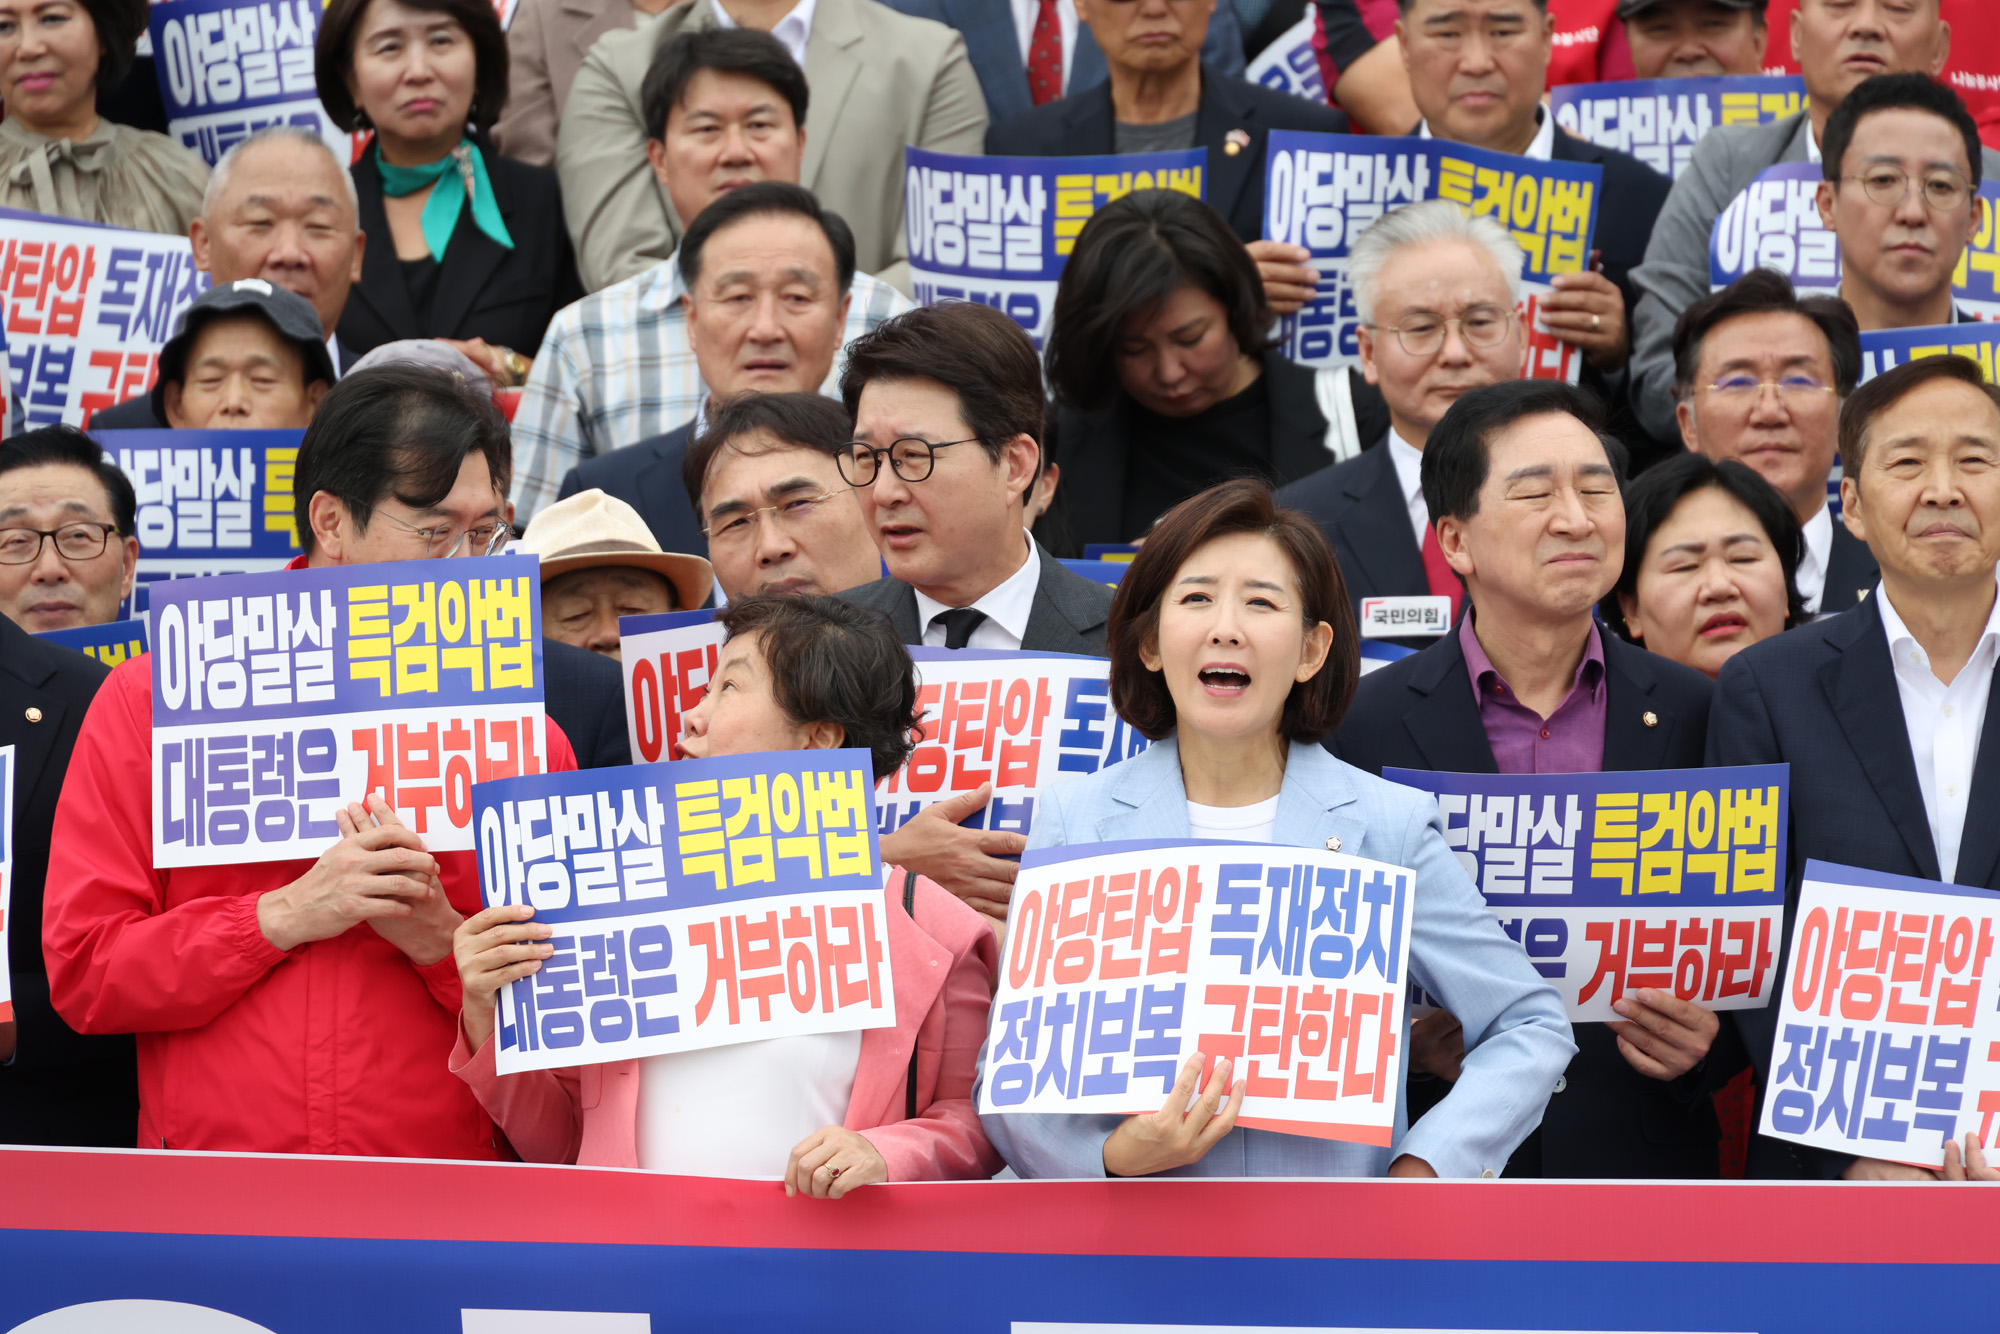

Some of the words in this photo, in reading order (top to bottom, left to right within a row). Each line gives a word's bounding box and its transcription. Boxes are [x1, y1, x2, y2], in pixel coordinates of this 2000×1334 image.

[163, 0, 317, 107] 야당말살
[907, 166, 1047, 271] 야당말살
[159, 588, 337, 711] 야당말살
[348, 576, 534, 697] 특검악법
[1373, 607, 1439, 624] 국민의힘
[162, 727, 340, 847] 대통령은
[351, 716, 541, 834] 거부하라
[875, 677, 1052, 793] 당탄압
[480, 786, 669, 911] 야당말살
[675, 770, 872, 890] 특검악법
[1434, 794, 1583, 895] 당말살
[1590, 786, 1780, 896] 특검악법
[688, 903, 883, 1027] 거부하라
[1008, 864, 1203, 990] 야당탄압
[1208, 863, 1407, 984] 독재정치
[1577, 916, 1773, 1006] 거부하라
[1792, 906, 1995, 1029] 야당탄압
[990, 982, 1187, 1108] 정치보복
[1198, 984, 1397, 1103] 규탄한다
[1771, 1023, 1972, 1149] 정치보복
